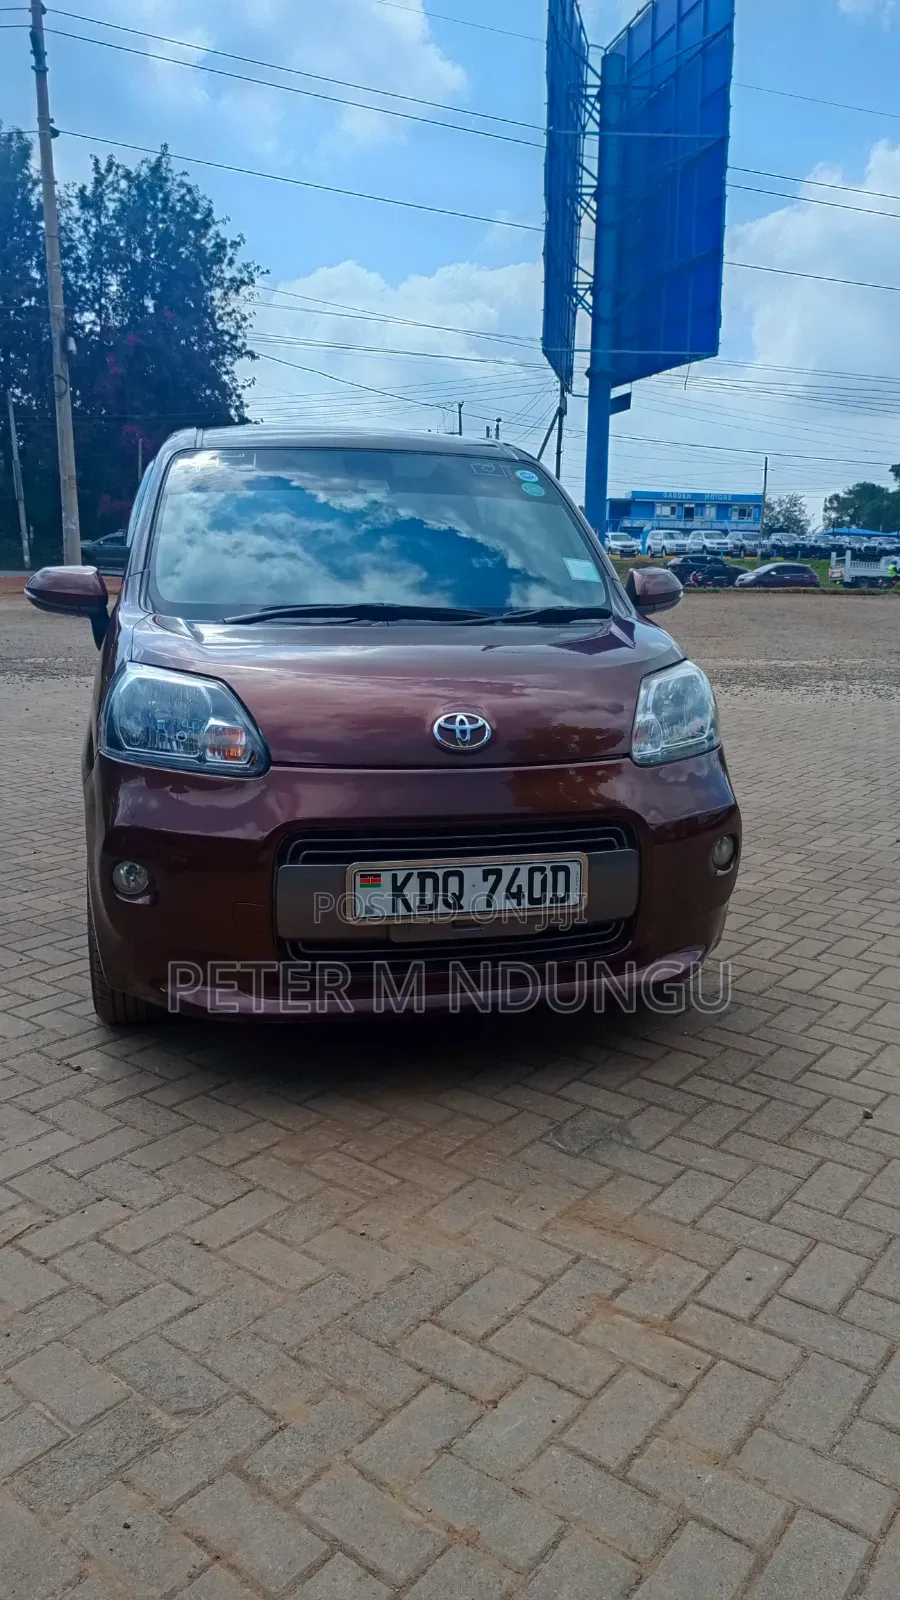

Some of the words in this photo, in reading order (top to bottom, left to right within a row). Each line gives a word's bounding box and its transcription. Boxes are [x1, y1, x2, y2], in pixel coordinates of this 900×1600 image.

[663, 492, 692, 500] GARDEN
[704, 493, 732, 501] MOTORS
[391, 869, 464, 914] KDQ
[482, 864, 571, 909] 740D
